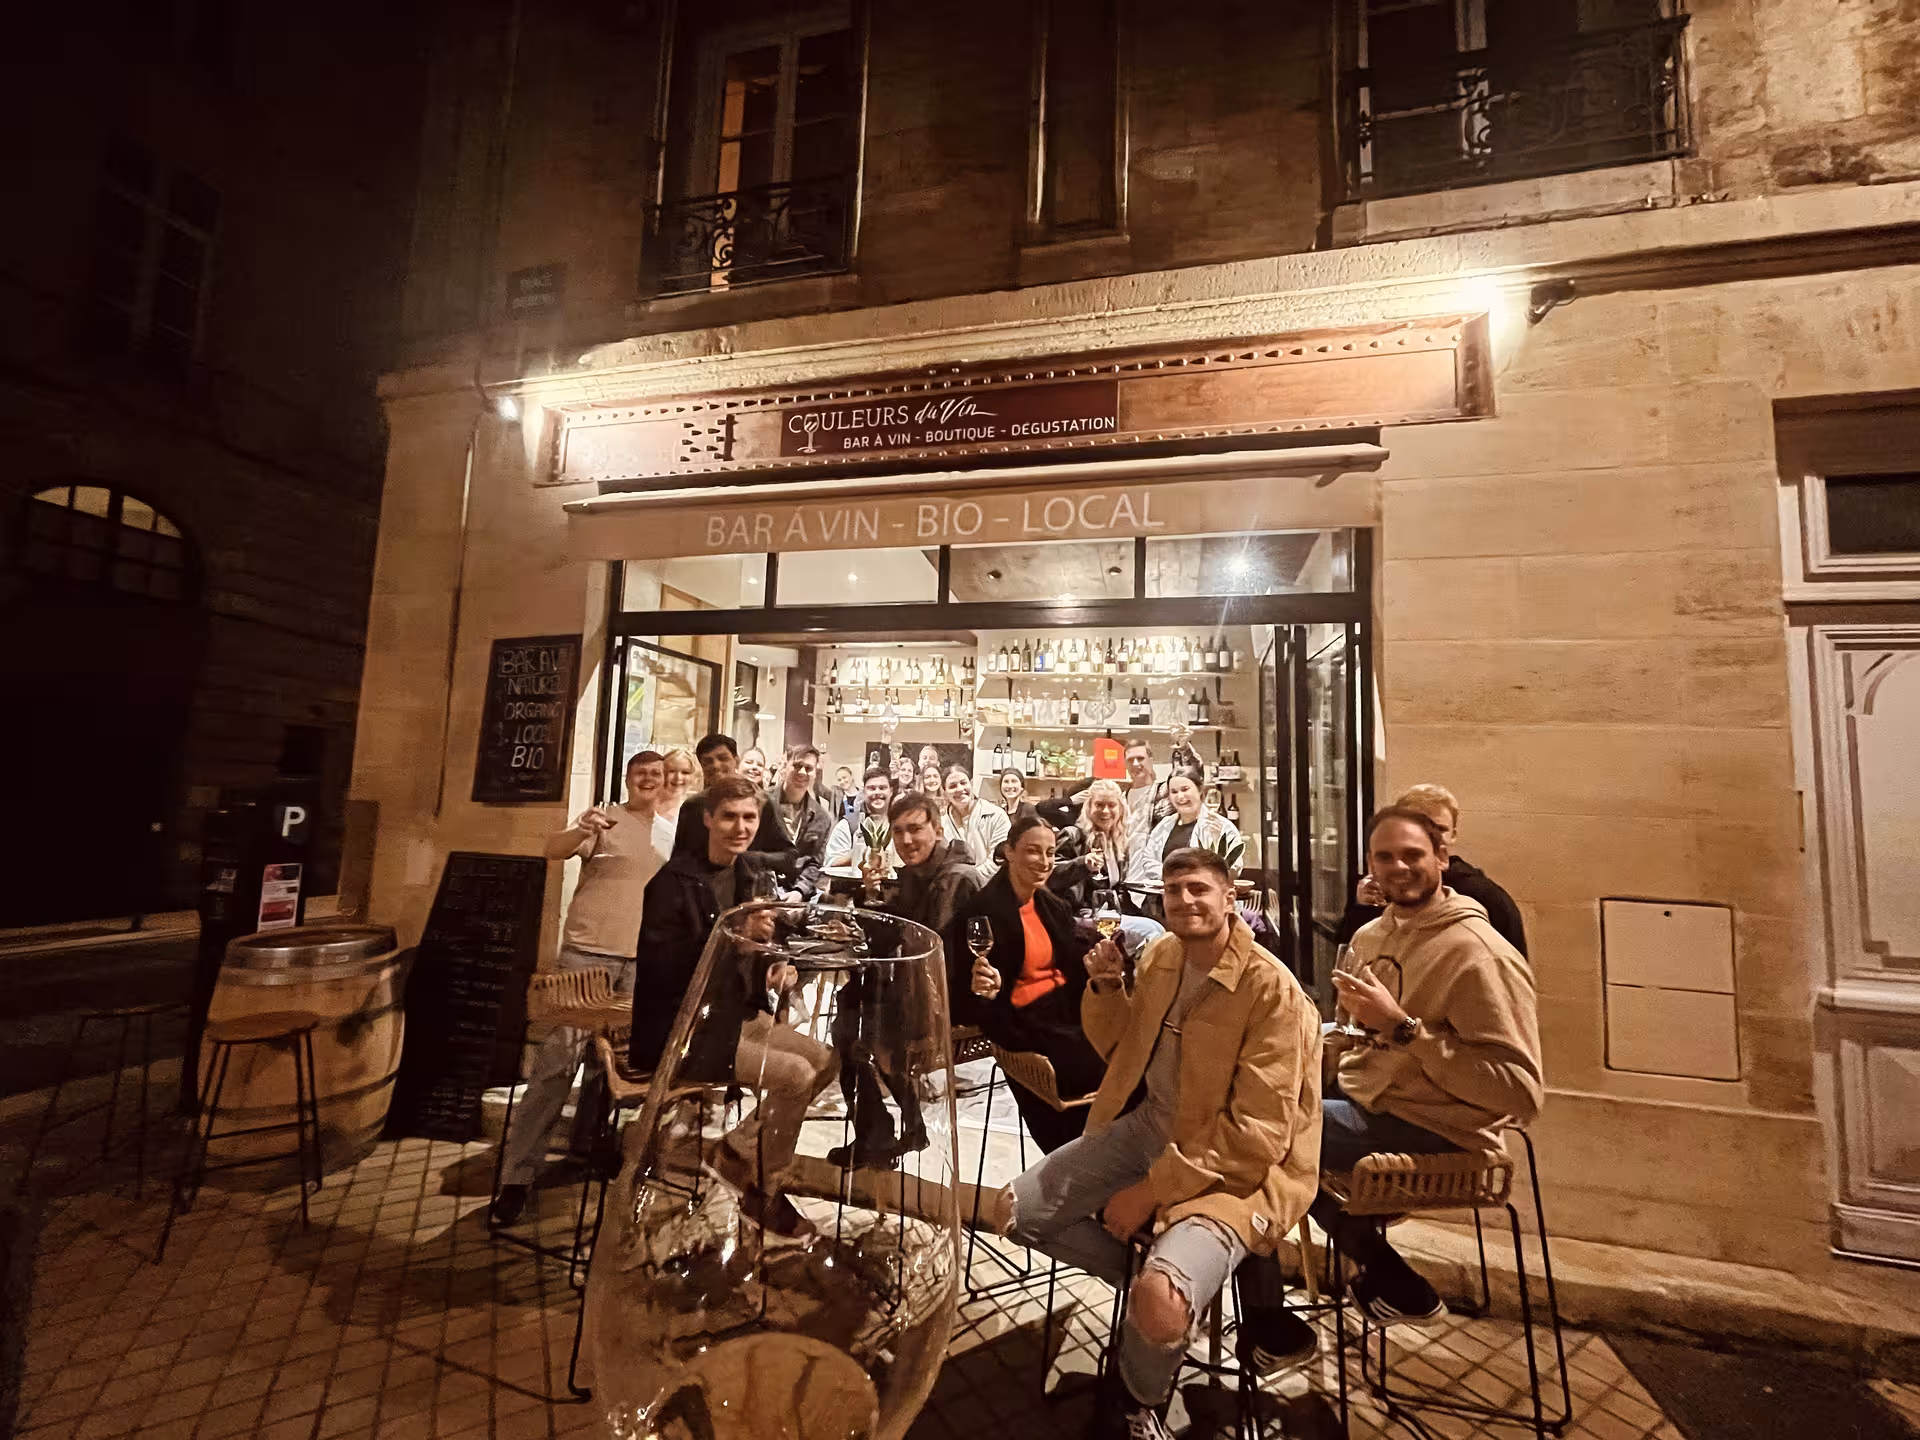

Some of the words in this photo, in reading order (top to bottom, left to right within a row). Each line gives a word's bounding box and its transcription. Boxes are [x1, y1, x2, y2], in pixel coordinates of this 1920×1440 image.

[788, 406, 909, 446] COULEURS
[914, 402, 938, 424] du
[940, 396, 998, 424] Vin
[843, 436, 870, 449] BAR
[888, 433, 911, 446] VIN
[925, 426, 996, 443] BOUTIQUE
[706, 513, 773, 547] BAR
[818, 508, 879, 542] VIN
[917, 502, 983, 537] BIO
[1023, 492, 1165, 532] LOCAL
[511, 745, 545, 770] BIO
[281, 806, 306, 837] P
